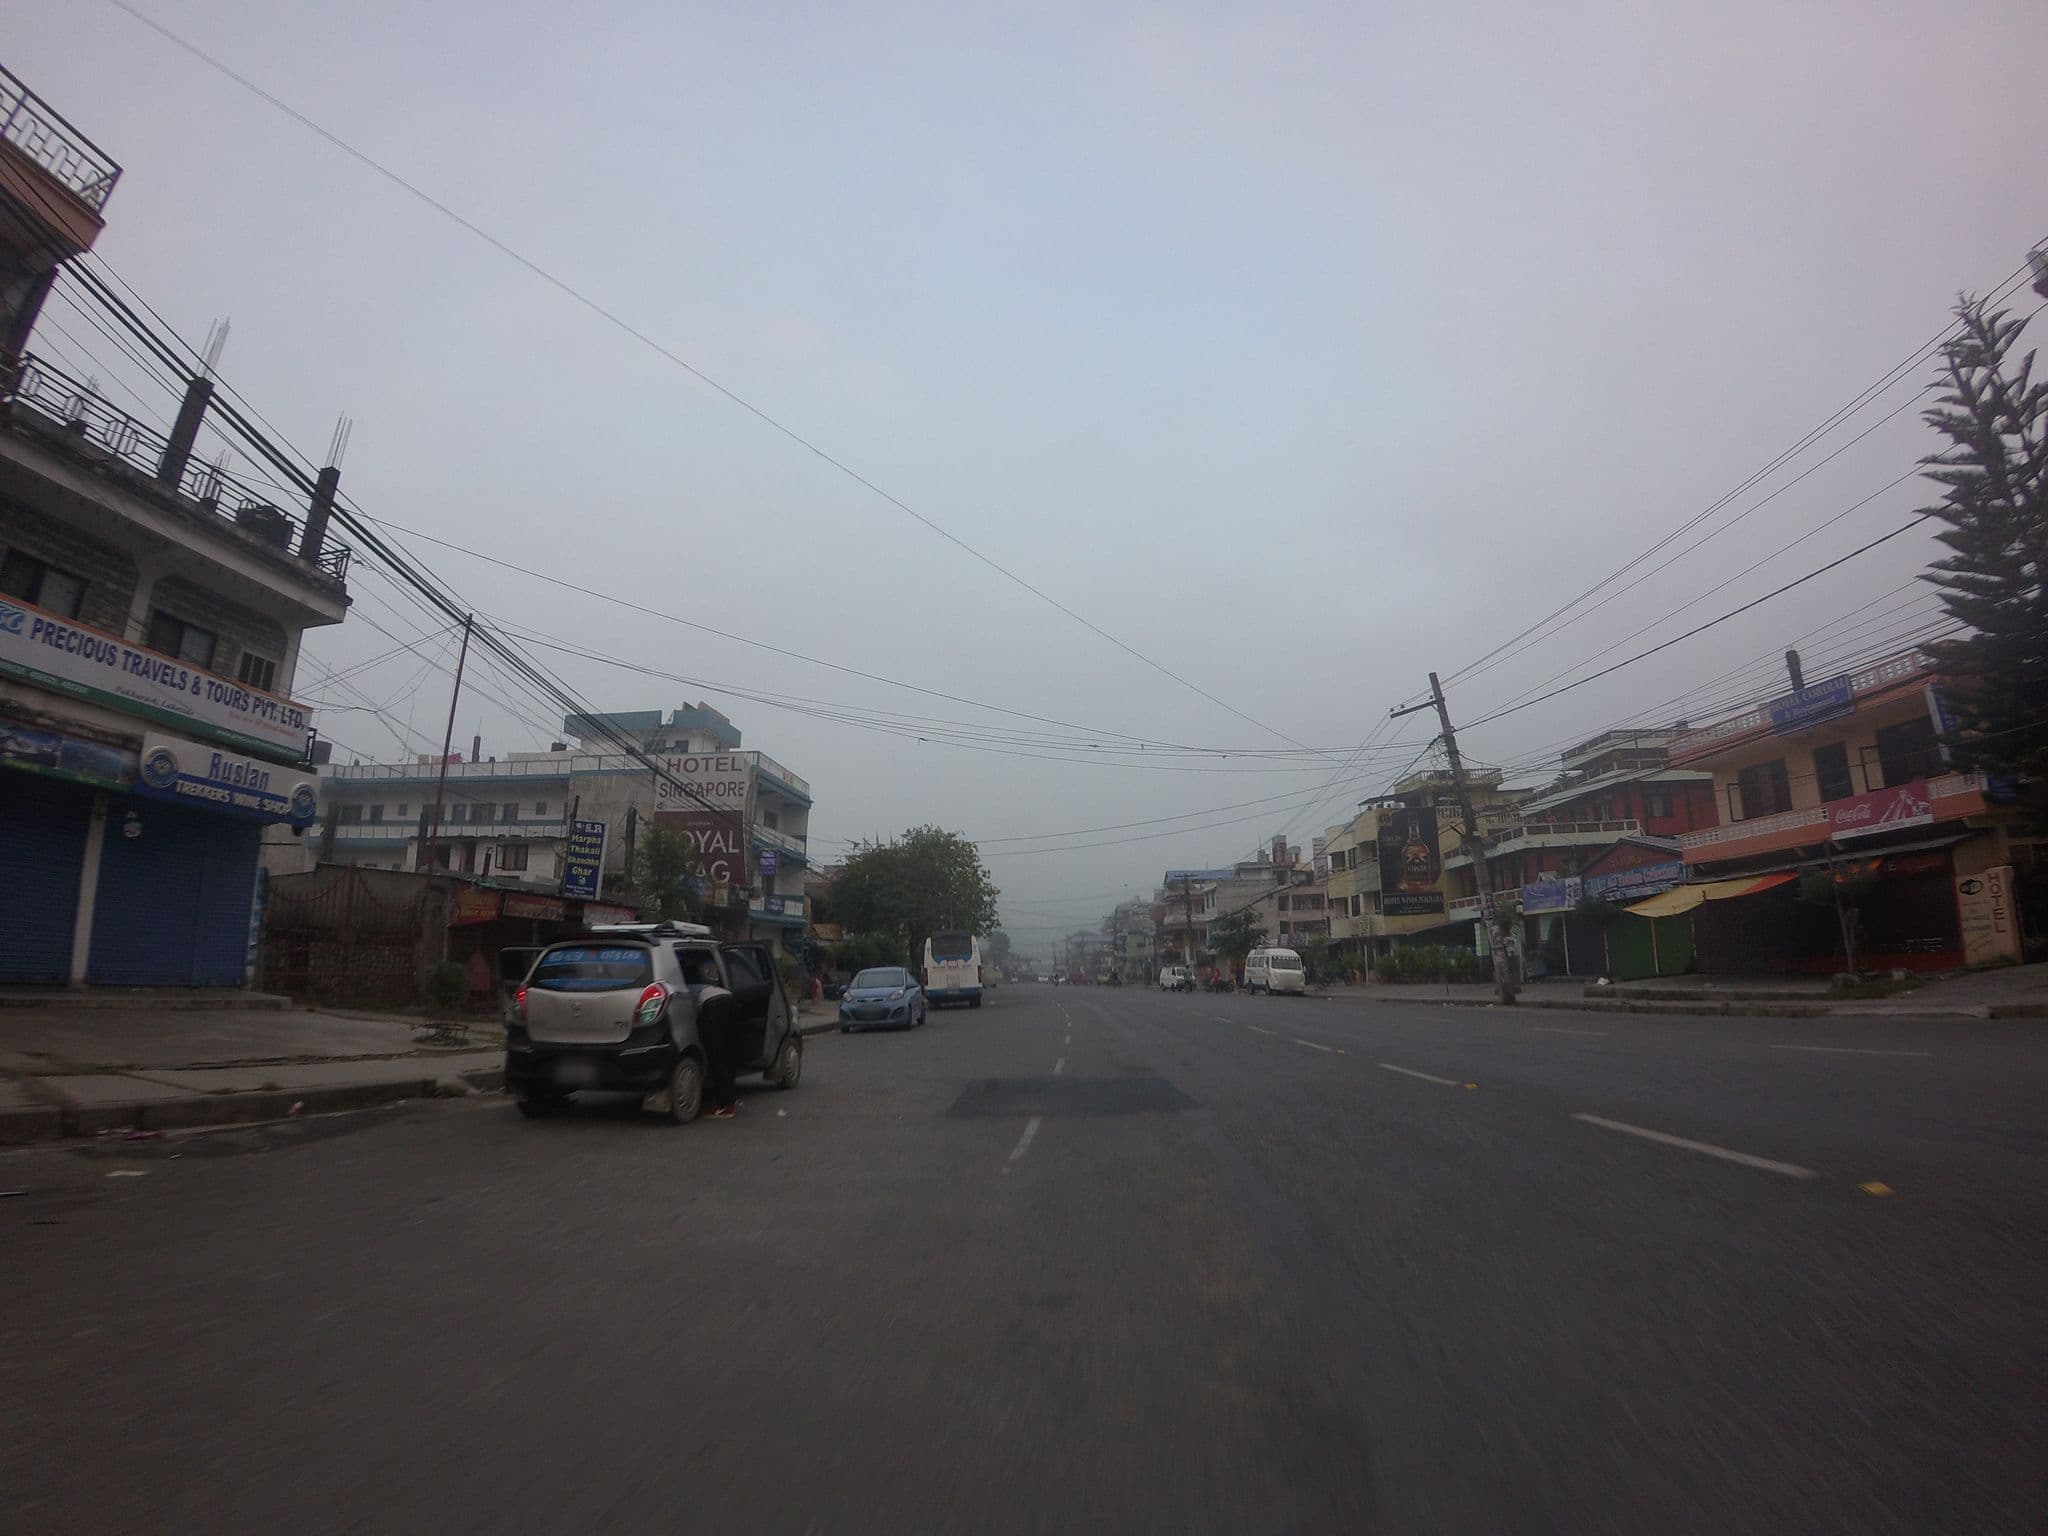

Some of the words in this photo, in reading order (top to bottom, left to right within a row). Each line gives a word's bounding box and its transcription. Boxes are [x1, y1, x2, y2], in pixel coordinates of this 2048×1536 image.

[30, 617, 118, 667] PRECIOUS
[121, 649, 188, 691] TRAVELS
[191, 675, 201, 696] &
[206, 680, 249, 712] TOURS
[208, 752, 270, 791] Ruslan
[666, 756, 743, 774] HOTEL
[659, 781, 745, 799] SINGAPORE
[571, 866, 593, 877] Ghar
[1987, 872, 2007, 934] HOTEL
